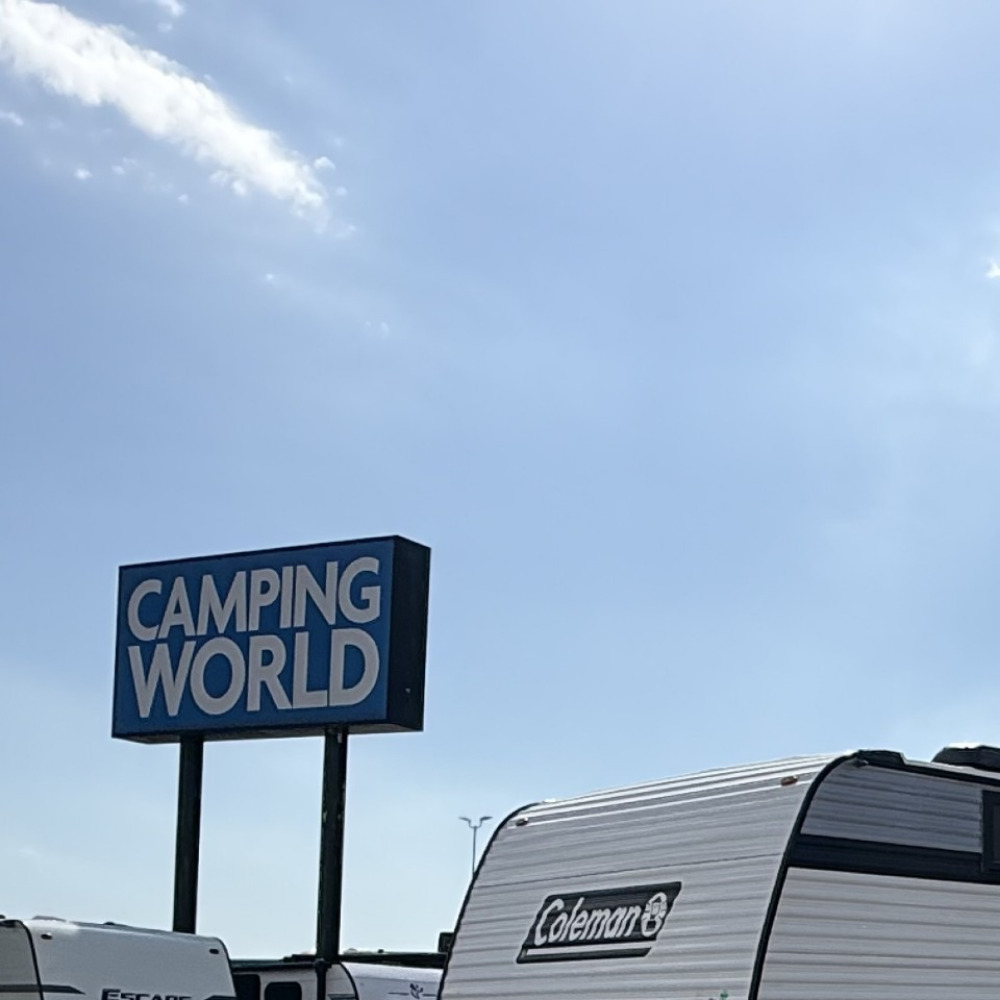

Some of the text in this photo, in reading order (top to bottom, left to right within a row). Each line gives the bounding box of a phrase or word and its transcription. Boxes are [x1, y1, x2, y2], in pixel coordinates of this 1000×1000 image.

[127, 556, 381, 641] CAMPING
[127, 628, 380, 718] WORLD
[533, 897, 642, 946] Coleman
